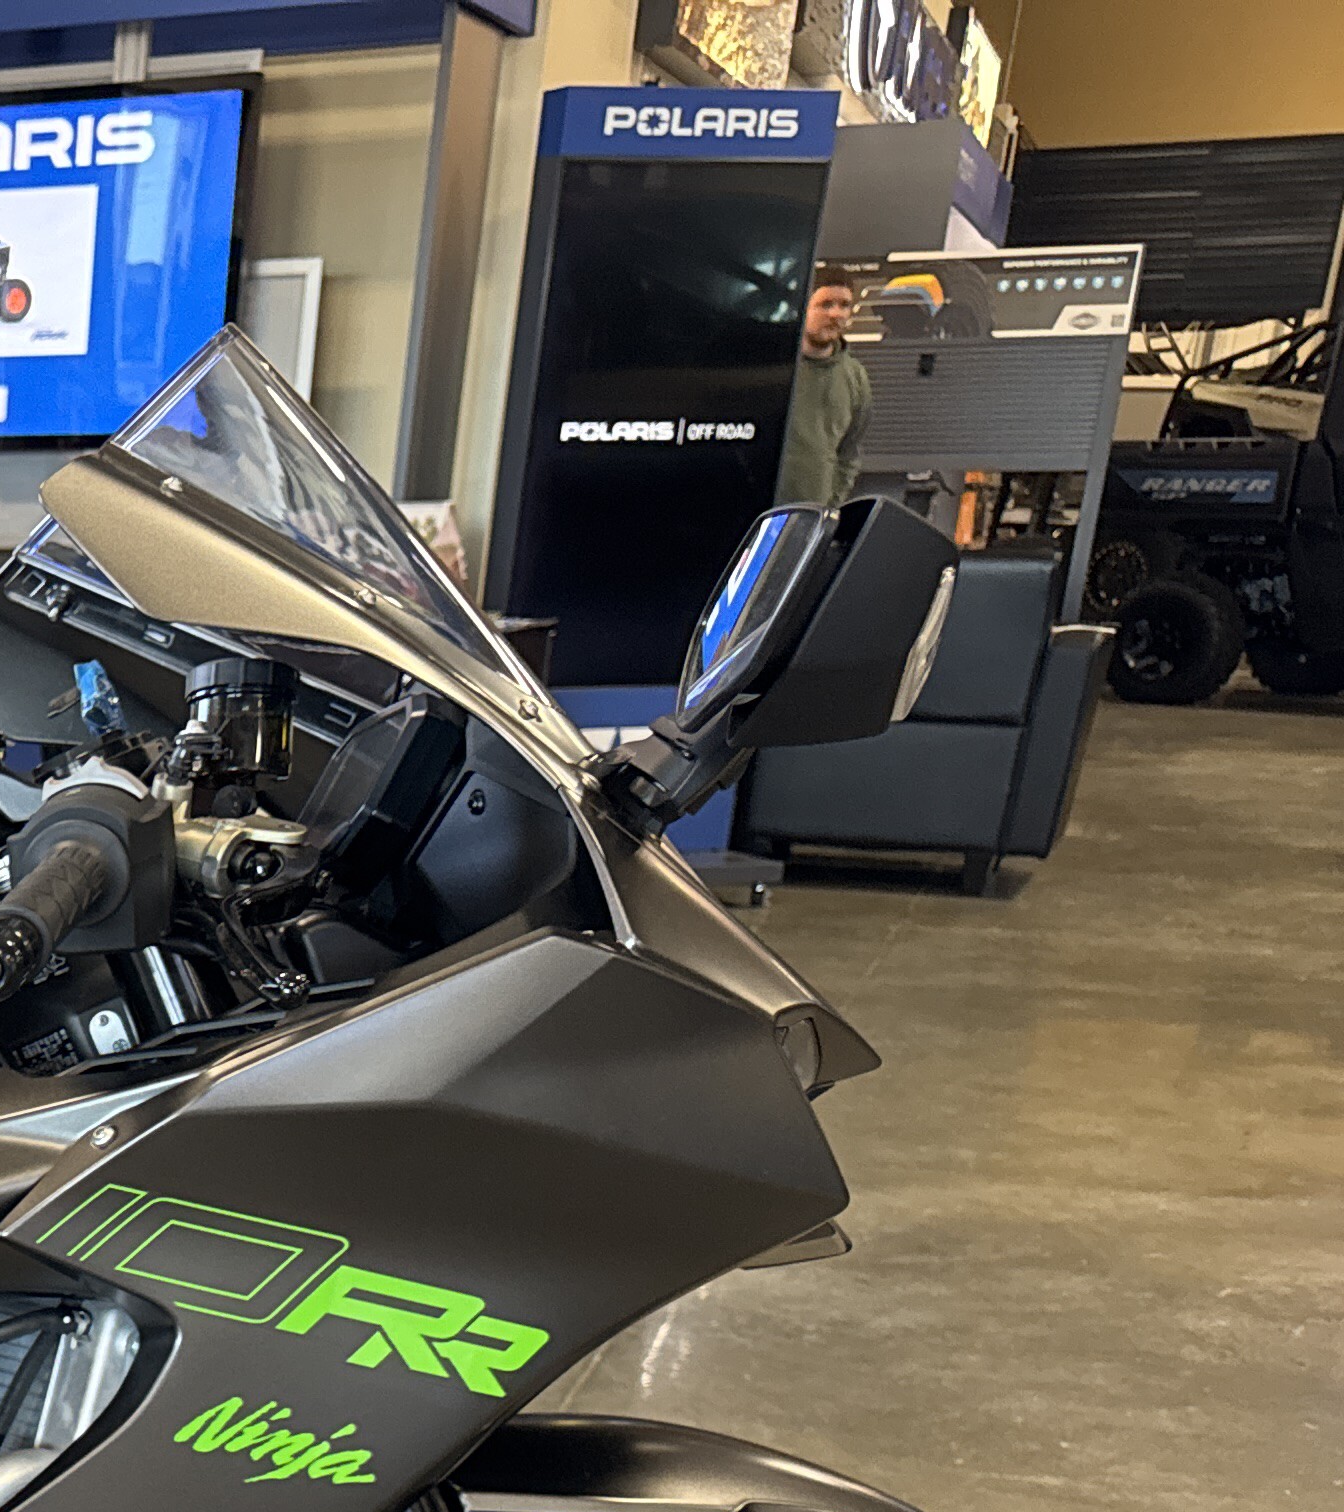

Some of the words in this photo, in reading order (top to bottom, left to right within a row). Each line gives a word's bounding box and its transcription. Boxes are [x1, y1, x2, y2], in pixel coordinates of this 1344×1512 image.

[603, 105, 799, 139] POLARIS
[559, 420, 675, 442] POLARIS
[686, 422, 715, 441] OFF
[715, 422, 756, 441] ROAD
[1141, 476, 1272, 493] RANGER
[173, 1396, 377, 1485] Ninja
